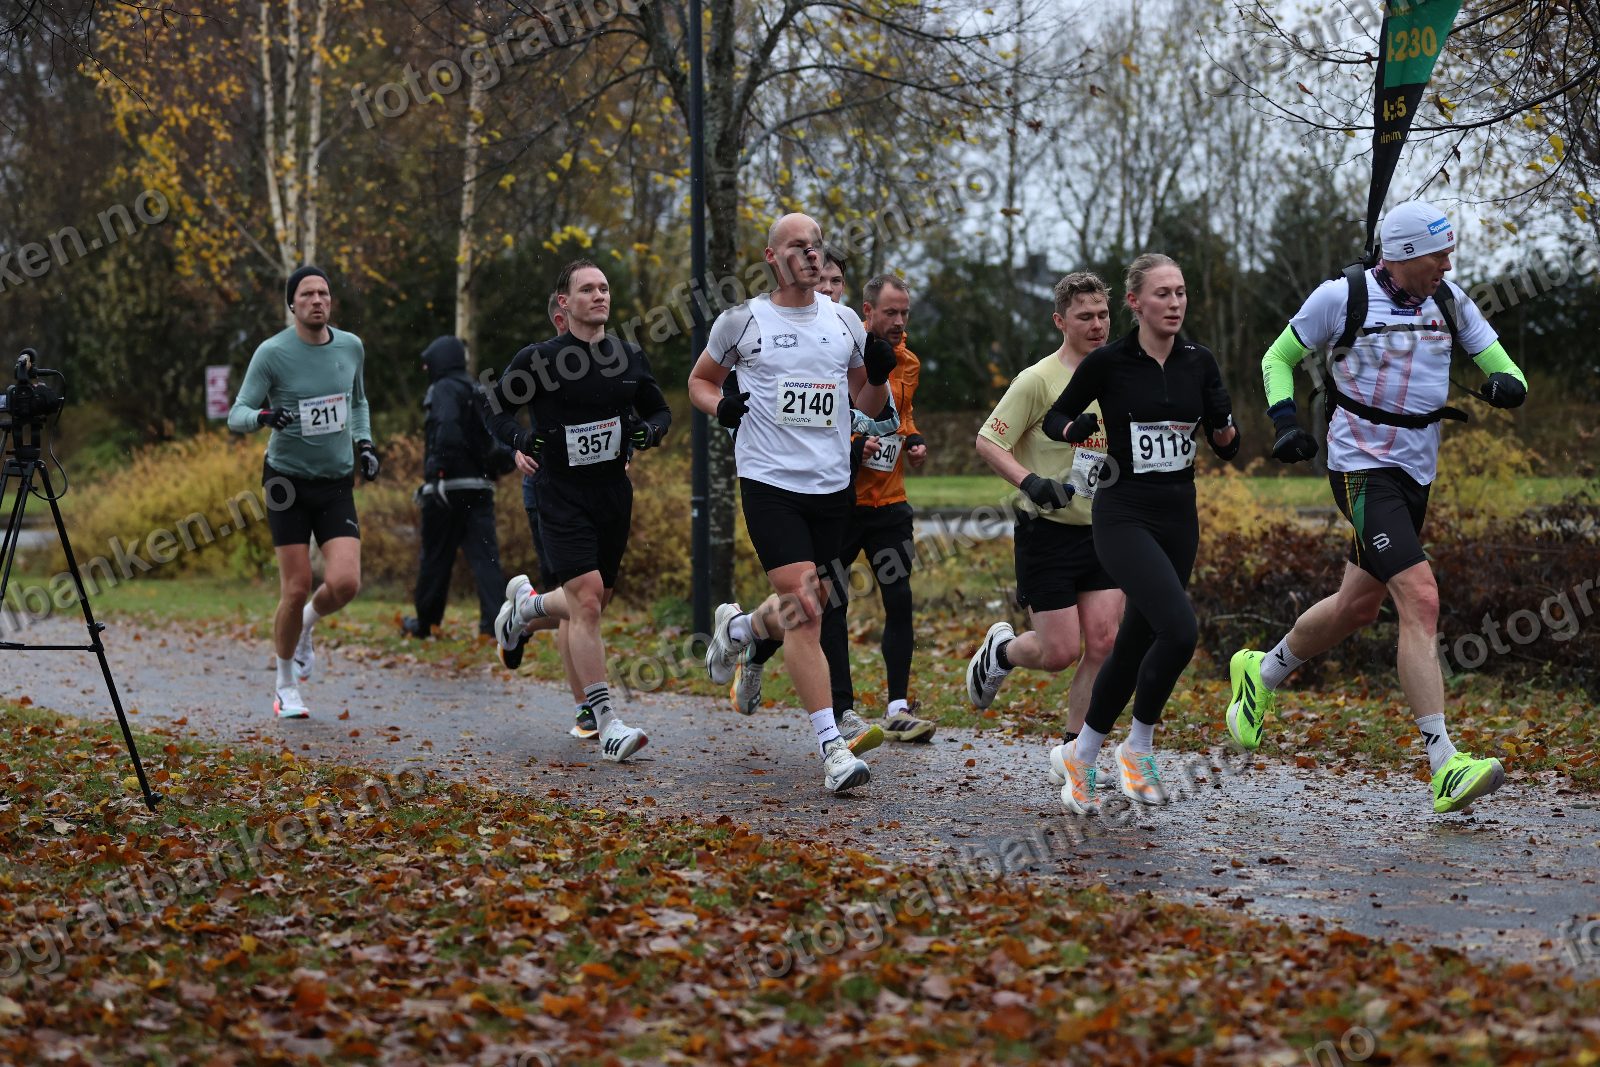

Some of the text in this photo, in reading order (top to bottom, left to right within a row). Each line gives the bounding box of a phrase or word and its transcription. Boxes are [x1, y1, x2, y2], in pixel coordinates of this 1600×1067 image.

[783, 381, 837, 390] NORGESTESTEN
[782, 390, 834, 416] 2140
[311, 405, 338, 426] 211
[570, 421, 617, 434] NORGESTESTEN
[578, 431, 613, 455] 357
[1139, 433, 1192, 460] 9118
[1087, 464, 1099, 488] 6
